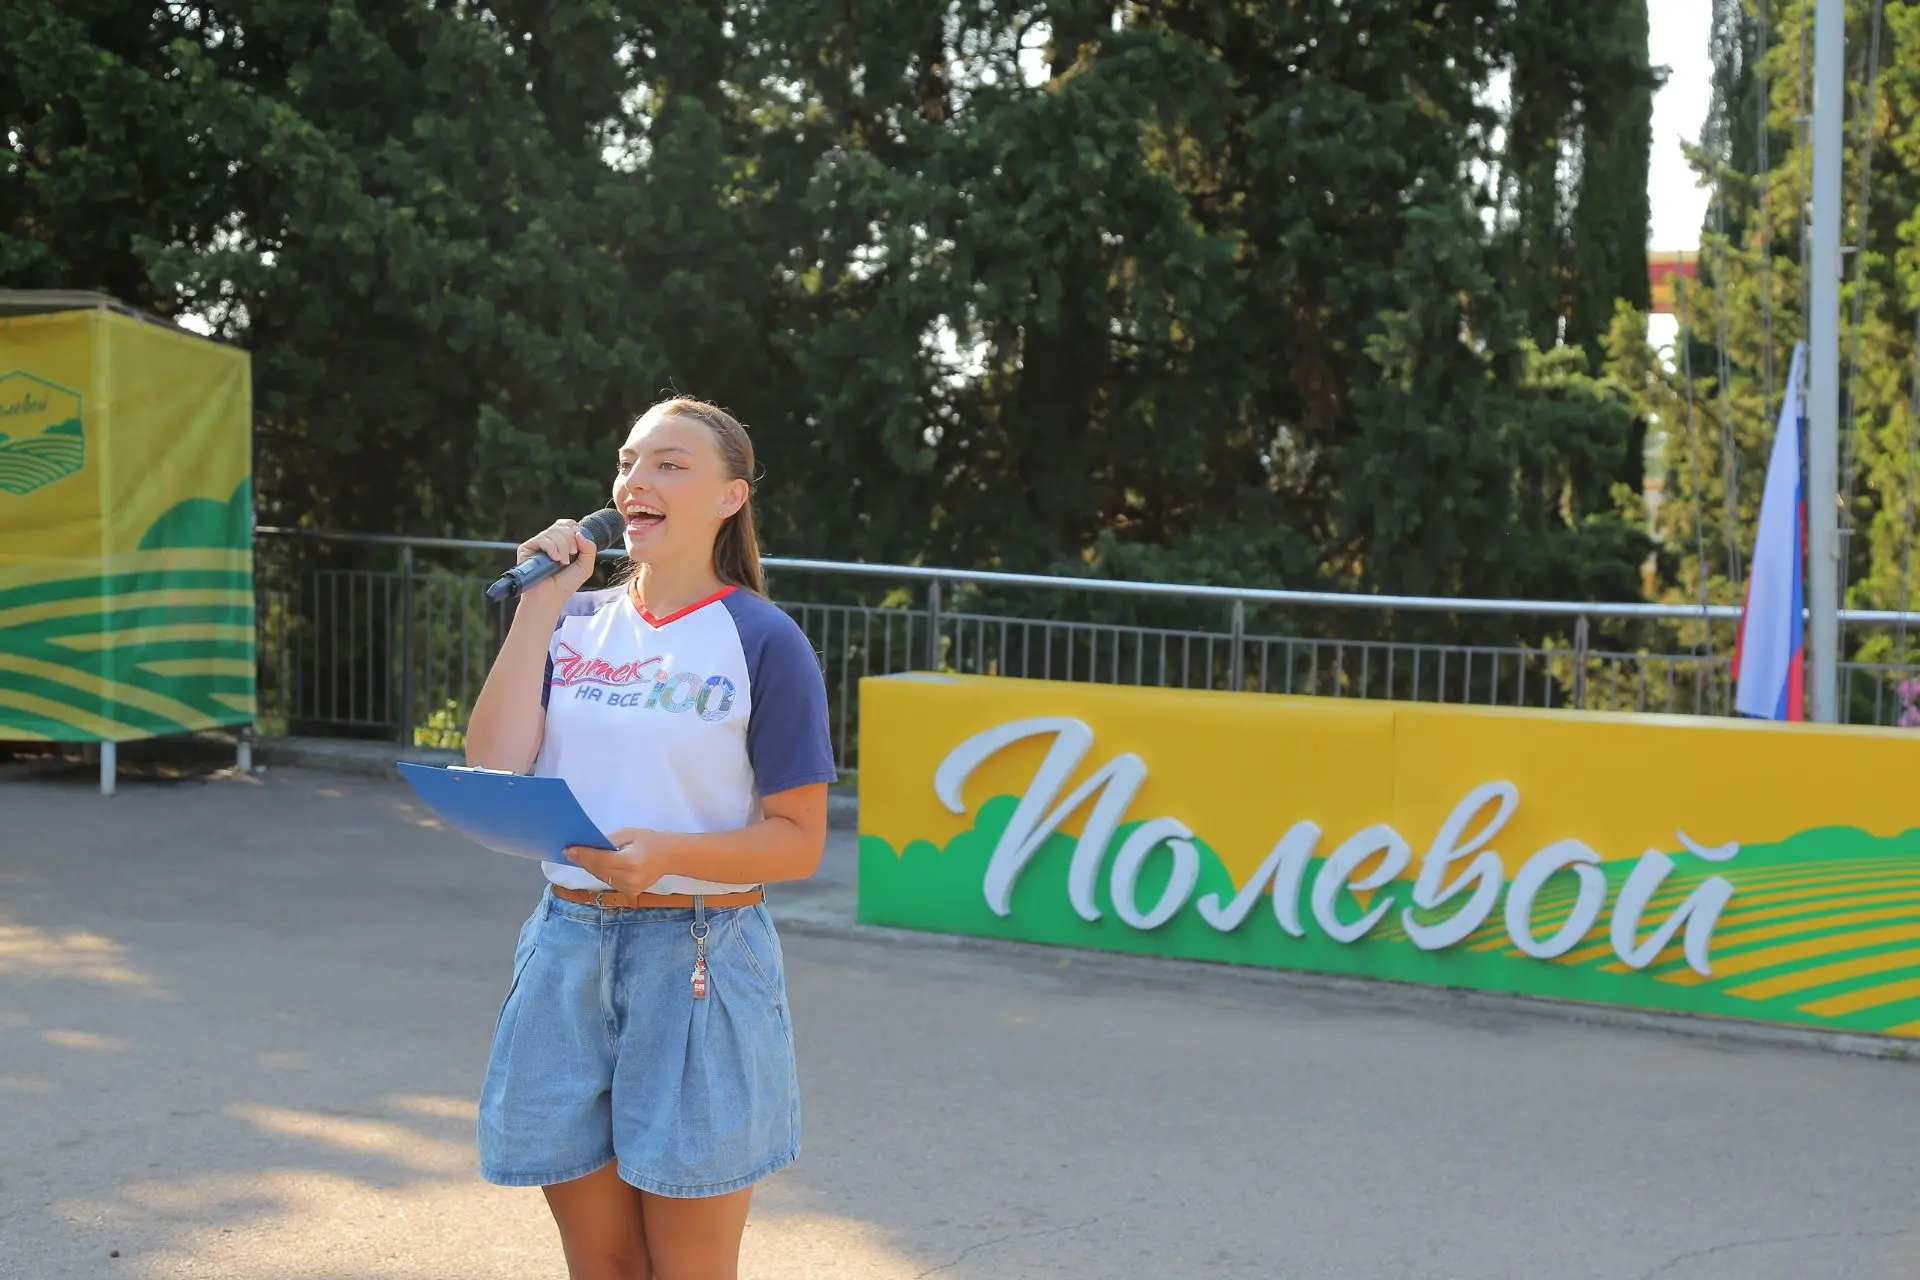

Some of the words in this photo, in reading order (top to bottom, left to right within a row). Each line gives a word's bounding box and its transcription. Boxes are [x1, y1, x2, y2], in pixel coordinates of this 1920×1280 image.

[553, 641, 663, 686] Артек
[574, 684, 602, 701] НА
[606, 691, 643, 708] ВСЕ
[644, 668, 737, 723] 100
[933, 715, 1740, 977] Полевой
